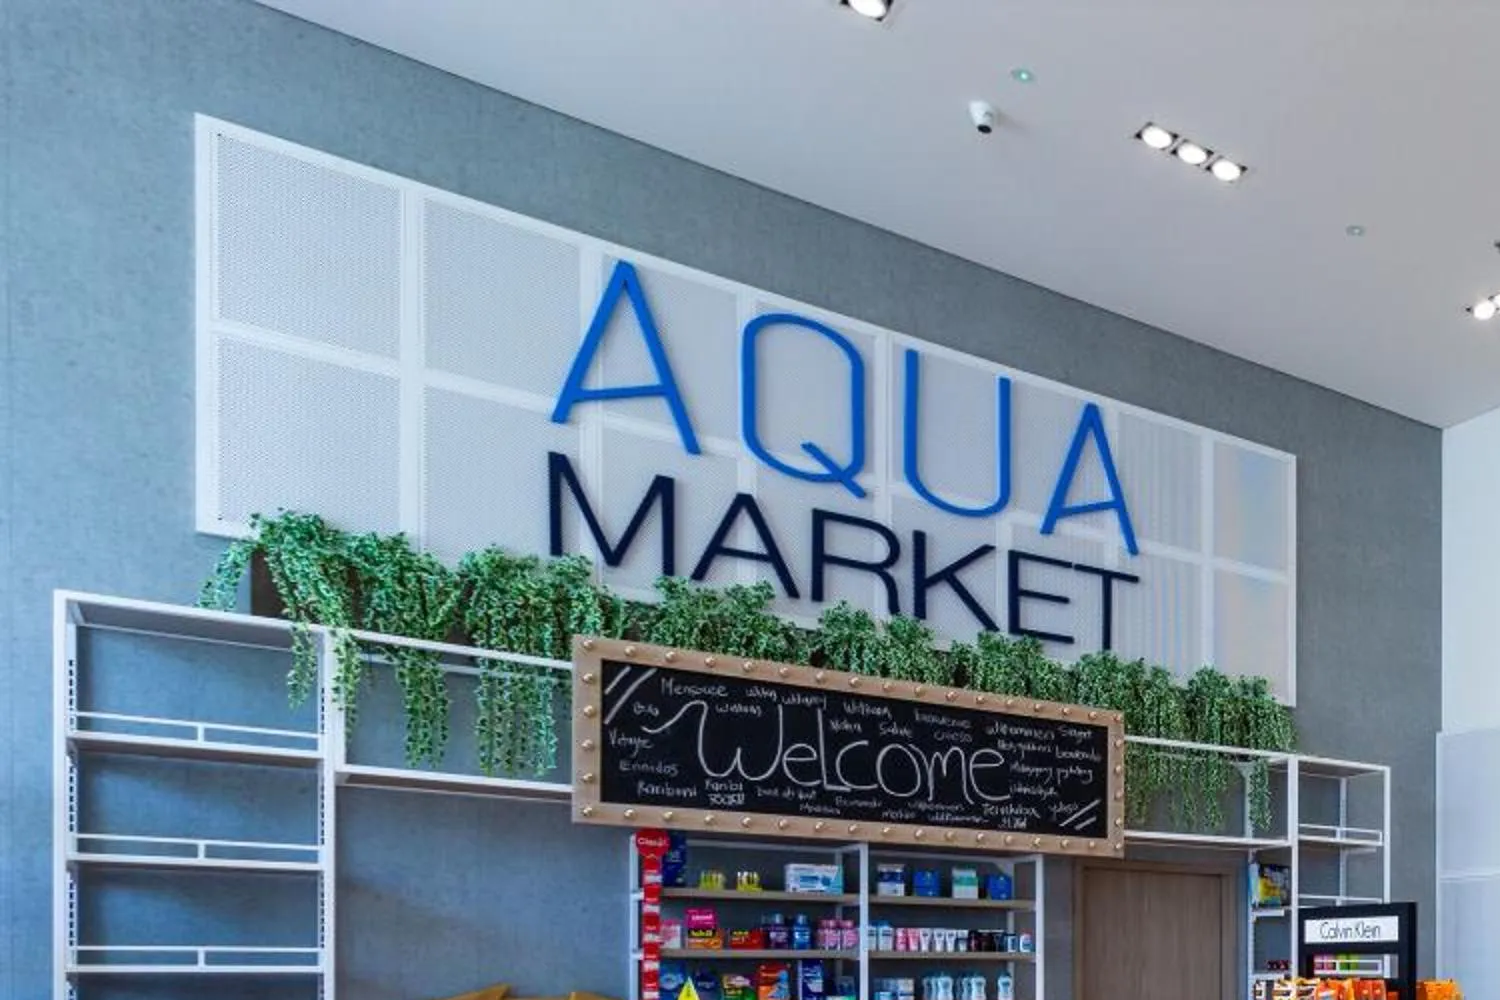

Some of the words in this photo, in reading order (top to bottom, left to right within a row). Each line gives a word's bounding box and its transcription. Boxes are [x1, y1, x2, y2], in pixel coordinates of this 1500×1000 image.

[551, 259, 1139, 556] AQUA
[548, 450, 1140, 651] MARKET
[1320, 921, 1353, 939] Calvin
[1355, 920, 1381, 938] Klein
